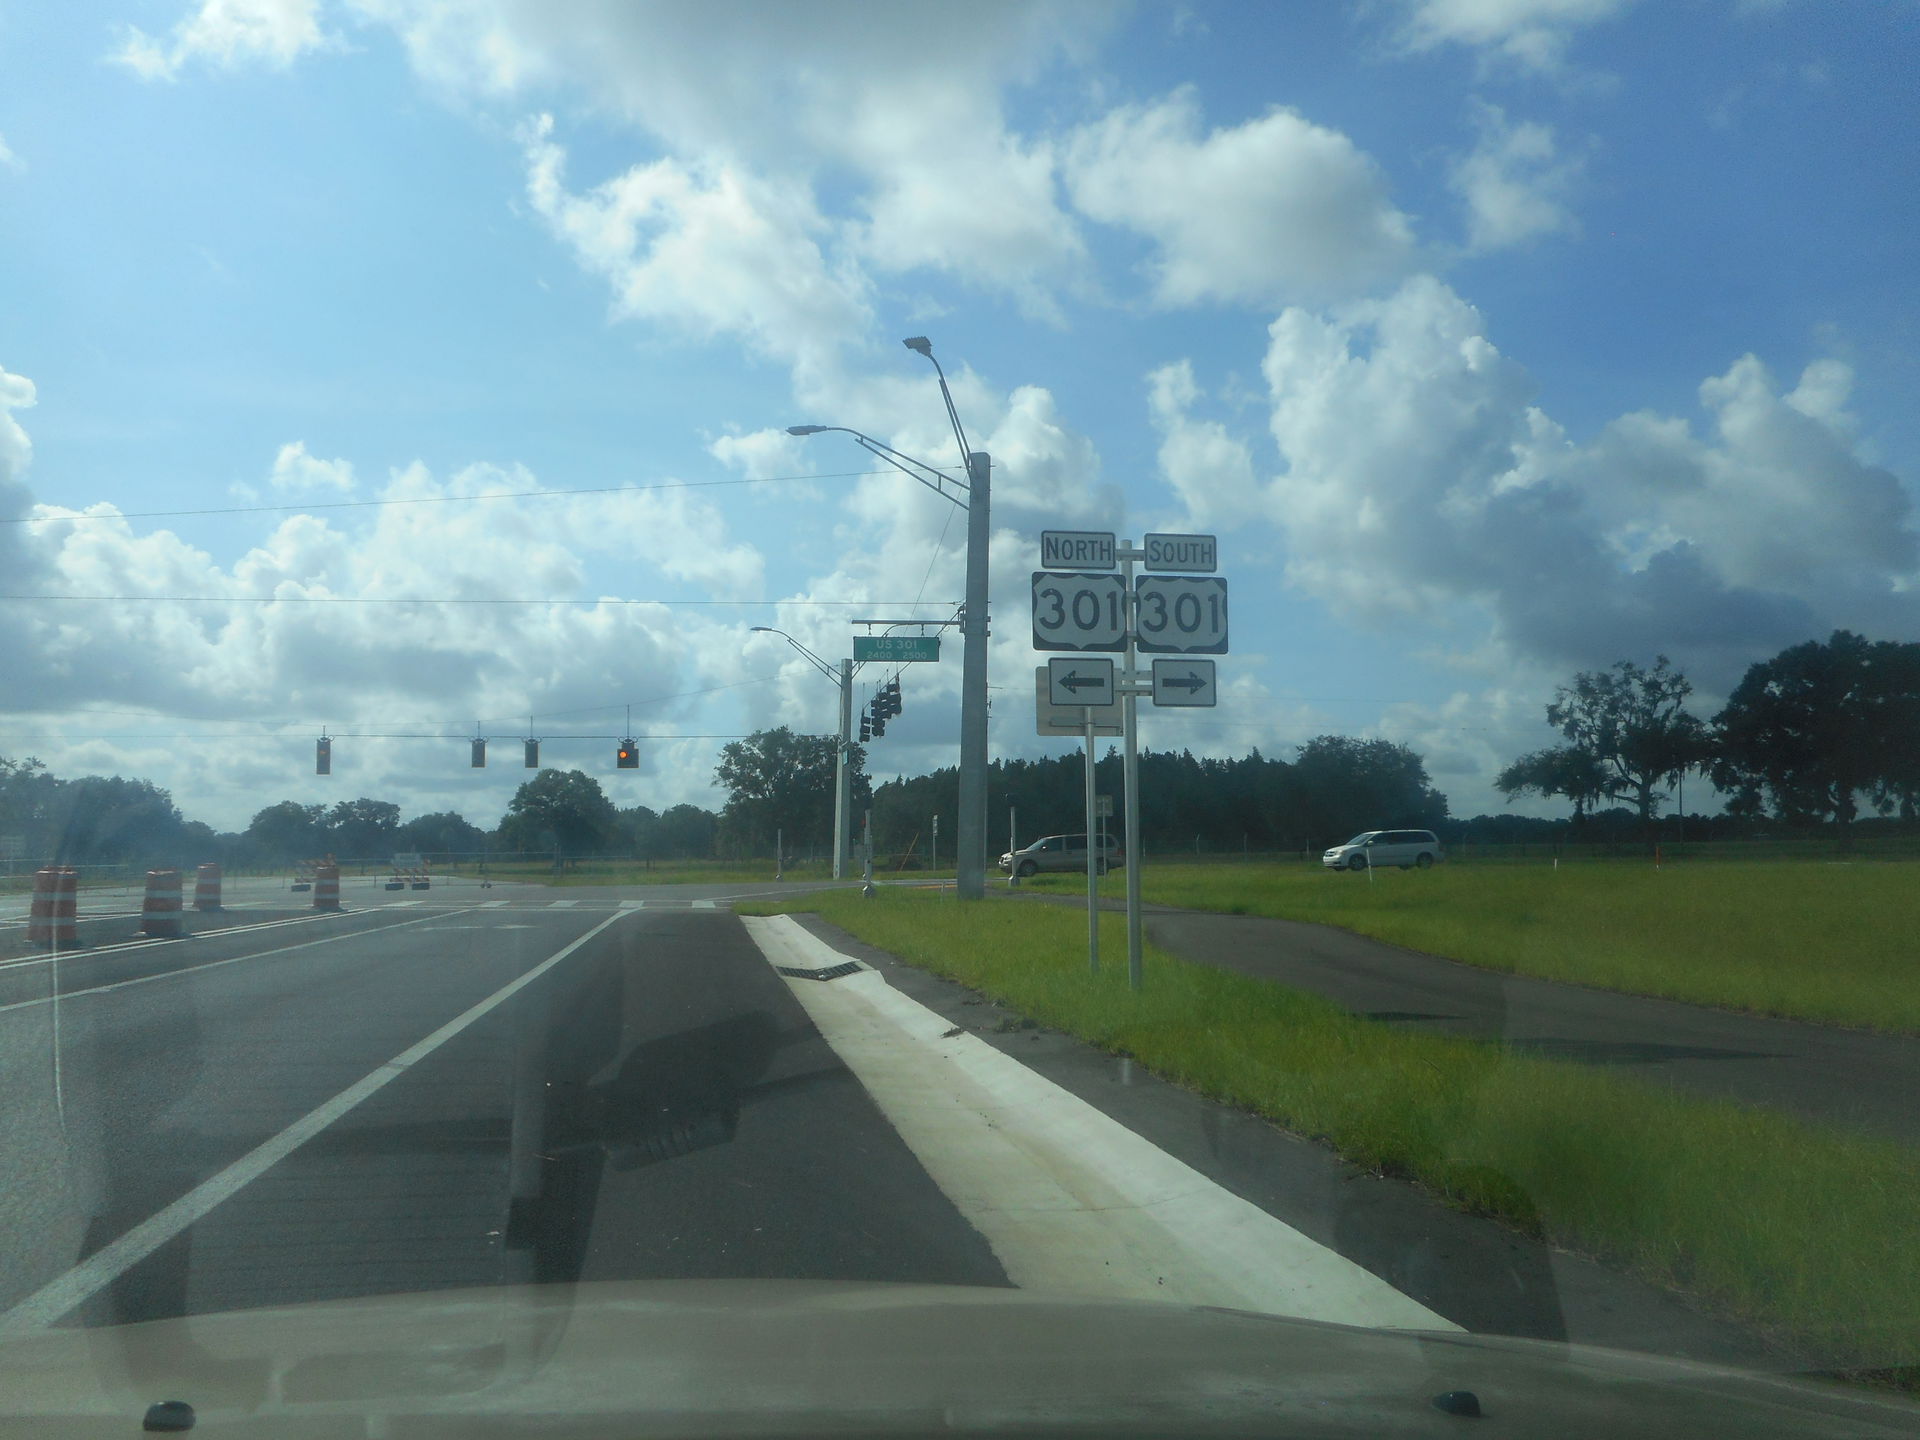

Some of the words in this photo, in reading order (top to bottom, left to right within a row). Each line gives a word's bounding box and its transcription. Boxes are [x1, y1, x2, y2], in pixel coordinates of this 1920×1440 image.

[1045, 537, 1111, 561] NORTH
[1149, 540, 1212, 563] SOUTH
[1039, 588, 1117, 631] 301
[1142, 591, 1218, 633] 301
[876, 640, 892, 649] US
[897, 640, 917, 649] 301
